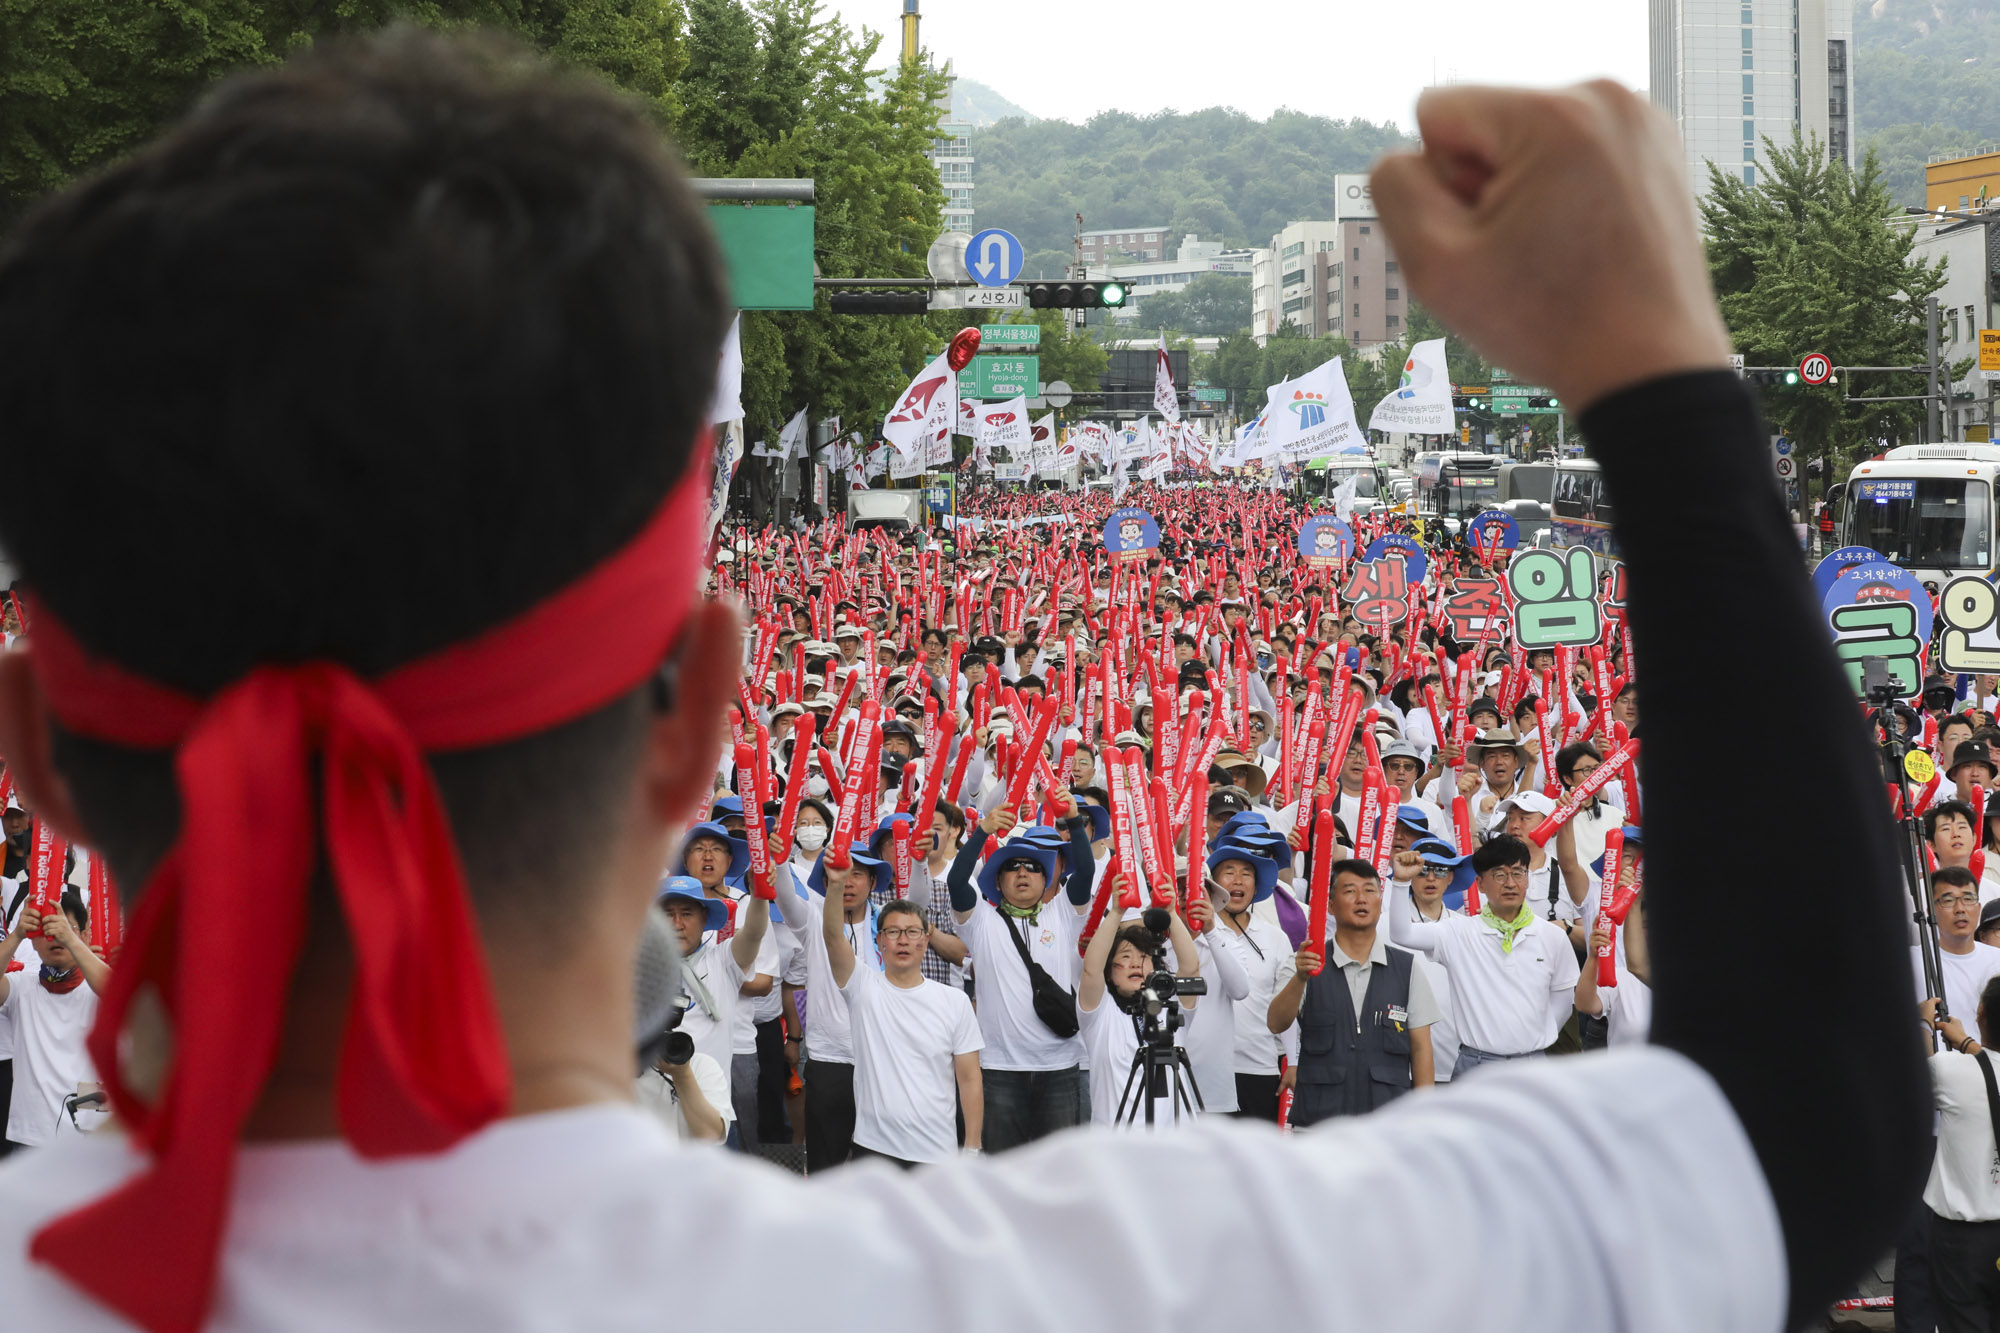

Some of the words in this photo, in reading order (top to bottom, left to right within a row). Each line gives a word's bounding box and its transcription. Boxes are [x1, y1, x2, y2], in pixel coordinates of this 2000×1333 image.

[981, 292, 1018, 304] 신호시
[984, 328, 1037, 340] 정부서울청사
[991, 362, 1025, 373] 효자동
[1806, 361, 1824, 377] 40
[988, 374, 1028, 382] Hyoja-dong
[1344, 556, 1407, 623] 생
[1445, 580, 1509, 642] 존
[1510, 547, 1600, 647] 임
[847, 776, 862, 789] 다
[1117, 817, 1130, 832] 다
